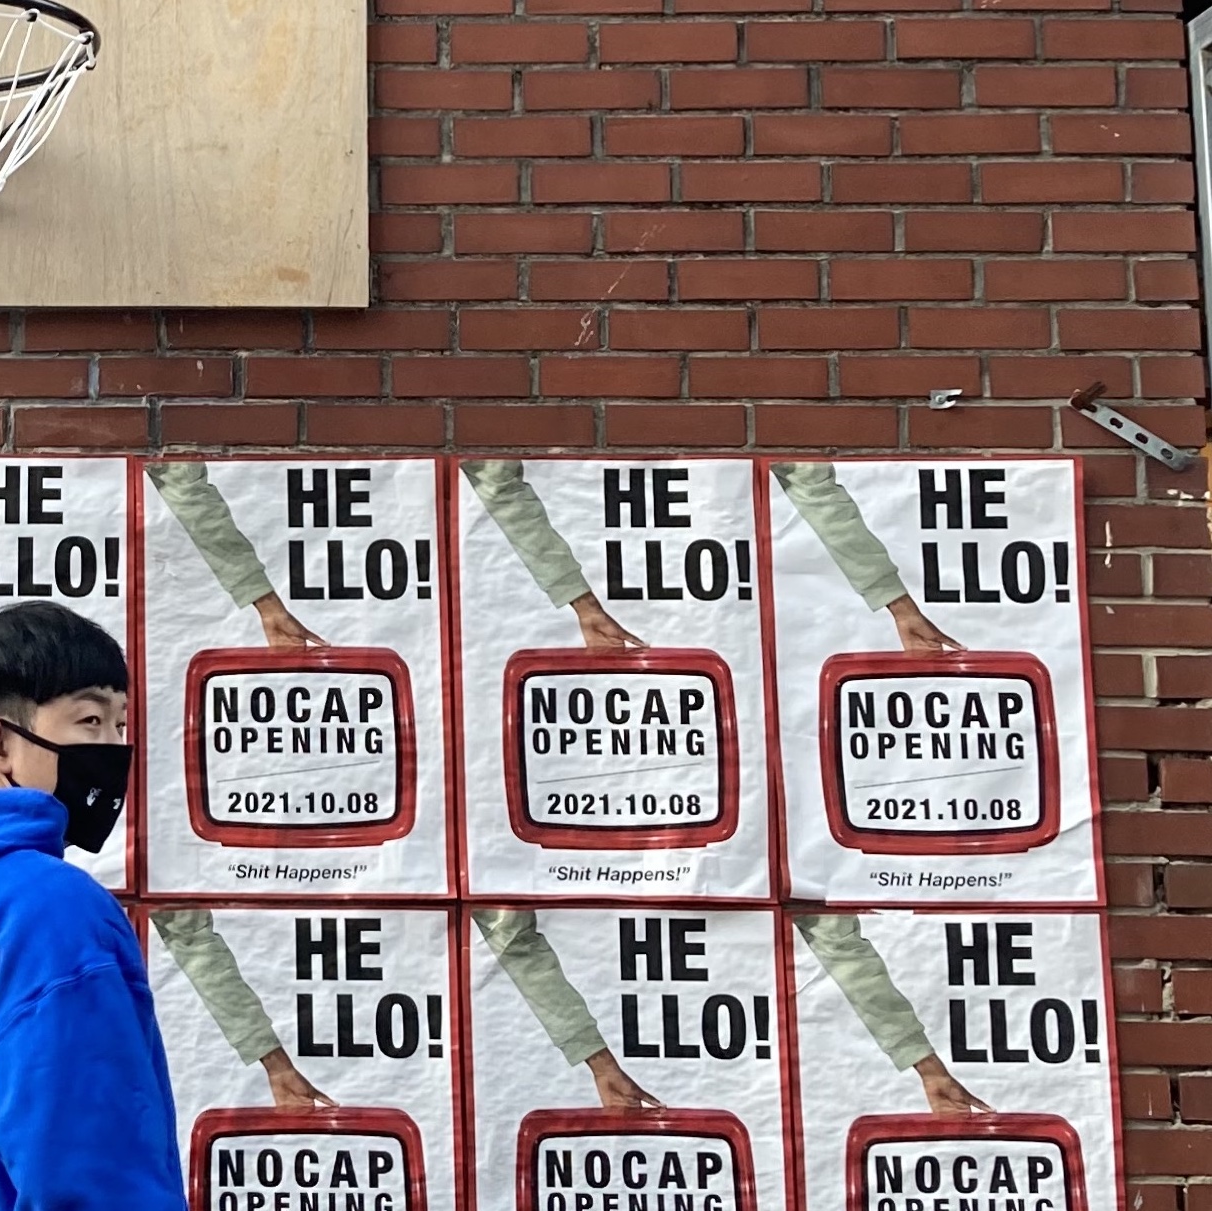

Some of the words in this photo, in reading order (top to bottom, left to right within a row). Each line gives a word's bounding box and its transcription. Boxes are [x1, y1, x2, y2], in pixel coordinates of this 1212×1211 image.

[287, 468, 372, 527] HE
[604, 468, 691, 528] HE
[919, 469, 1008, 529] HE
[289, 539, 431, 600] LLO!
[606, 539, 752, 601] LLO!
[922, 541, 1070, 603] LLO!
[214, 687, 382, 723] NOCAP
[532, 688, 704, 724] NOCAP
[848, 692, 1023, 728] NOCAP
[214, 727, 382, 754] OPENING
[533, 728, 704, 755] OPENING
[850, 733, 1024, 759] OPENING
[229, 792, 377, 813] 2021.10.08
[548, 794, 700, 815] 2021.10.08
[867, 799, 1021, 820] 2021.10.08
[229, 865, 270, 878] “Shit
[276, 865, 367, 882] Happens!”
[549, 867, 591, 880] “Shit
[597, 867, 690, 884] Happens!”
[870, 872, 912, 886] “Shit
[919, 873, 1011, 889] Happens!”
[296, 918, 383, 980] HE
[619, 918, 708, 981] HE
[945, 923, 1035, 985] HE
[297, 994, 443, 1058] LLO!
[622, 994, 770, 1059] LLO!
[949, 998, 1100, 1063] LLO!
[219, 1149, 393, 1188] NOCAP
[546, 1150, 722, 1189] NOCAP
[875, 1156, 1052, 1193] NOCAP
